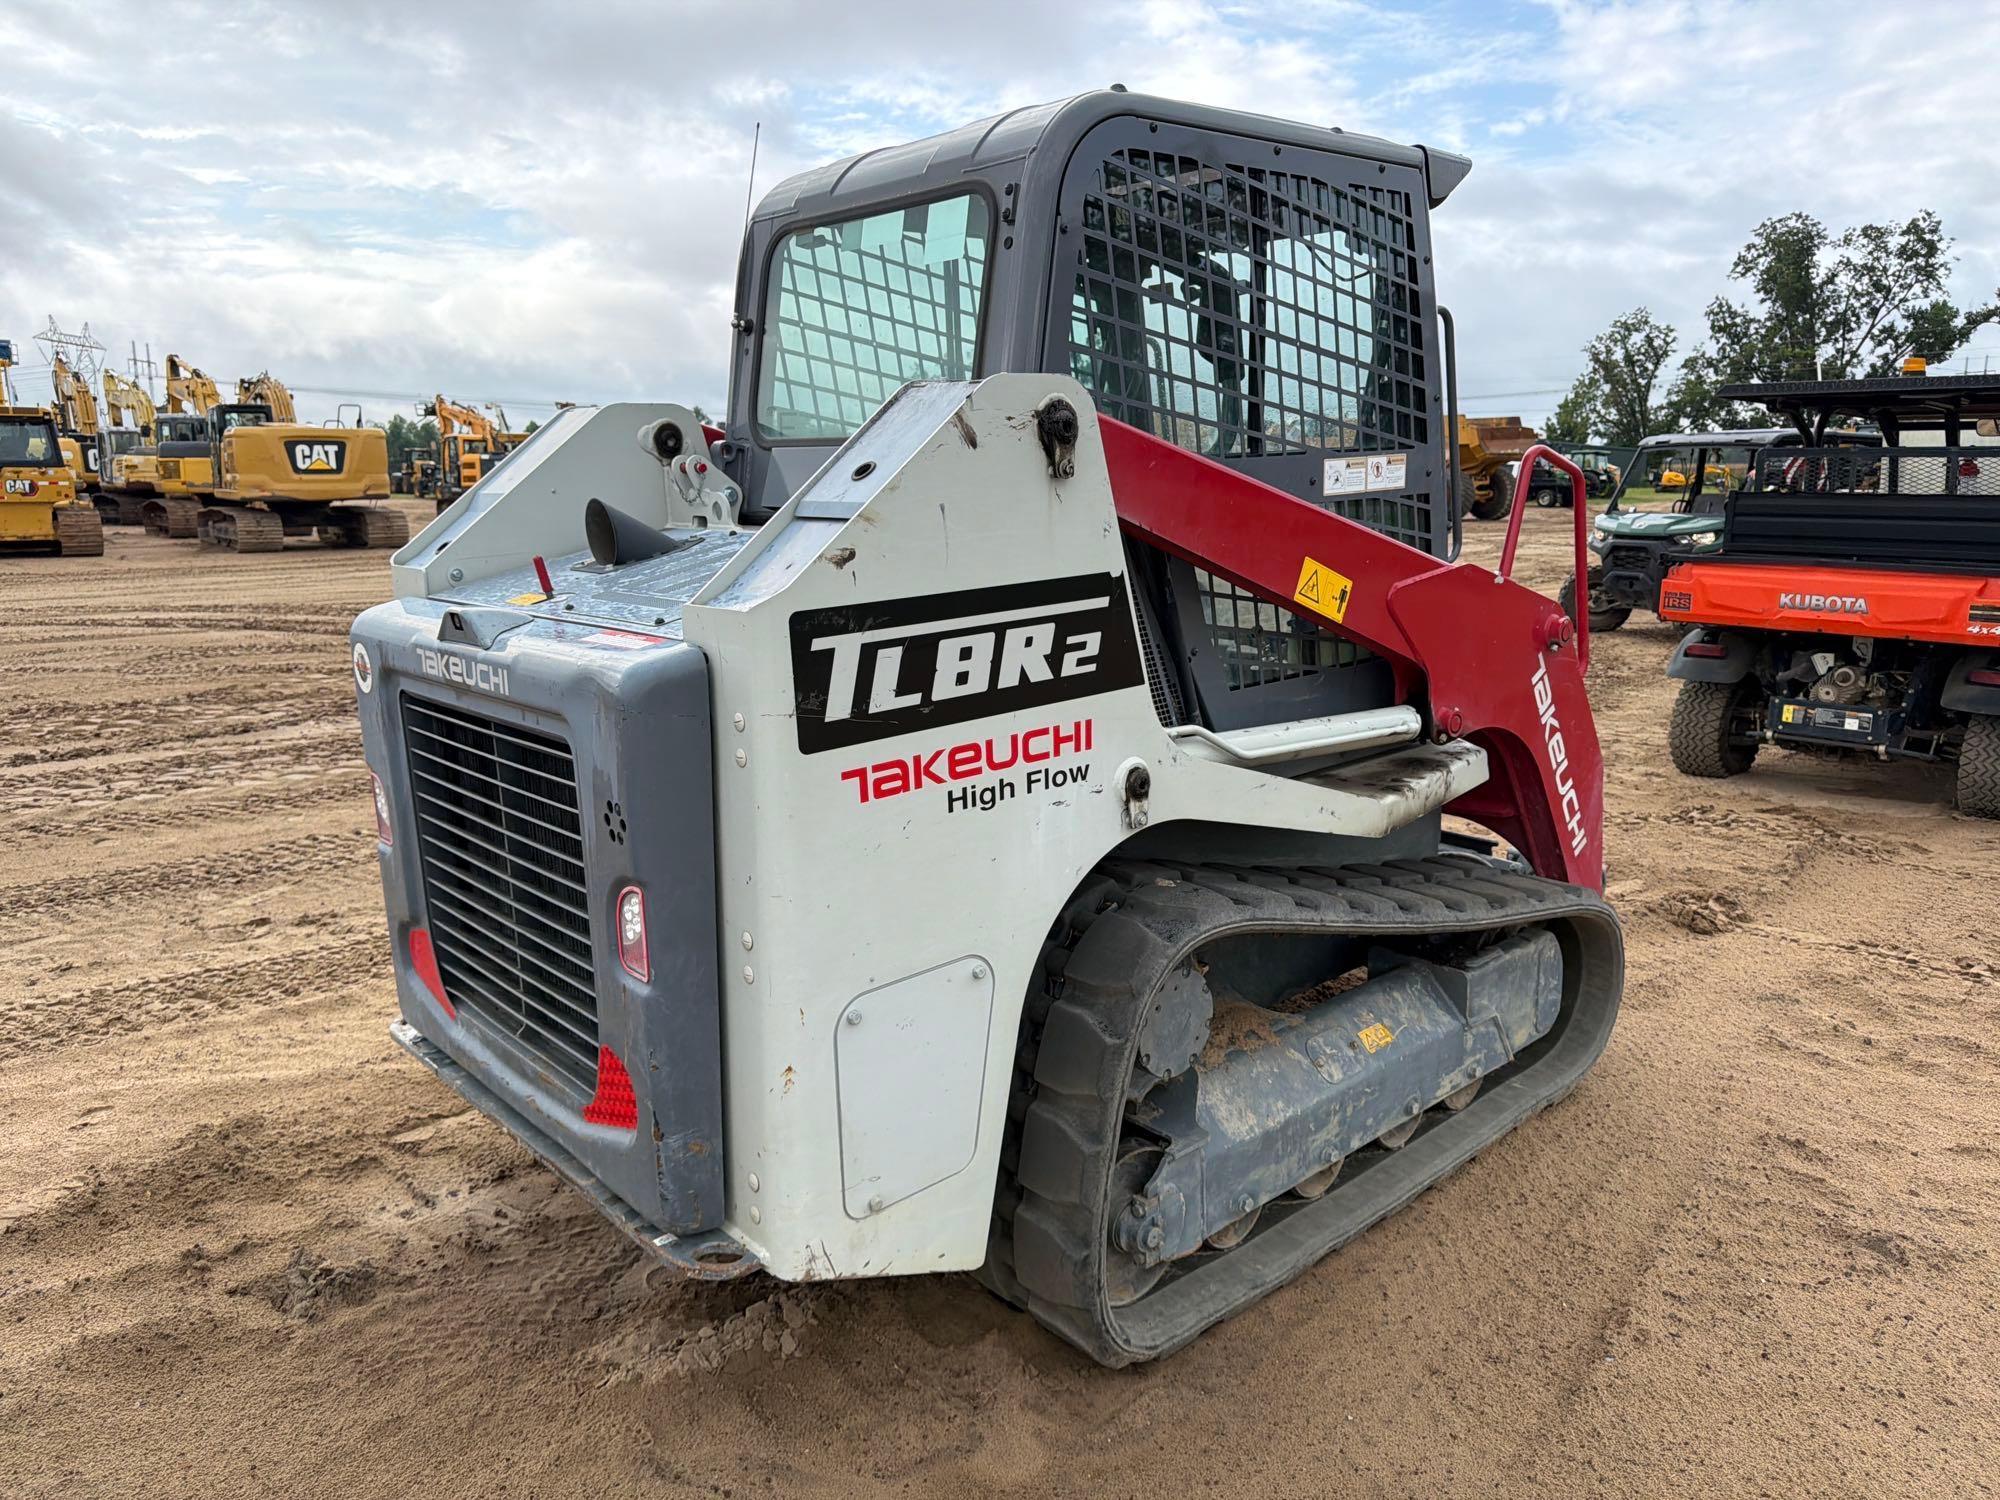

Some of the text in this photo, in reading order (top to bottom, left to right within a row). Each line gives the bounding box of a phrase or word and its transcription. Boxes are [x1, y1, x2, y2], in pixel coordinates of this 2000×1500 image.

[294, 443, 339, 470] CAT
[5, 479, 32, 493] CAT
[1664, 597, 1690, 608] IRS
[1778, 593, 1869, 614] KUBOTA
[810, 596, 1110, 723] TL8R2
[947, 763, 1090, 814] High Flow
